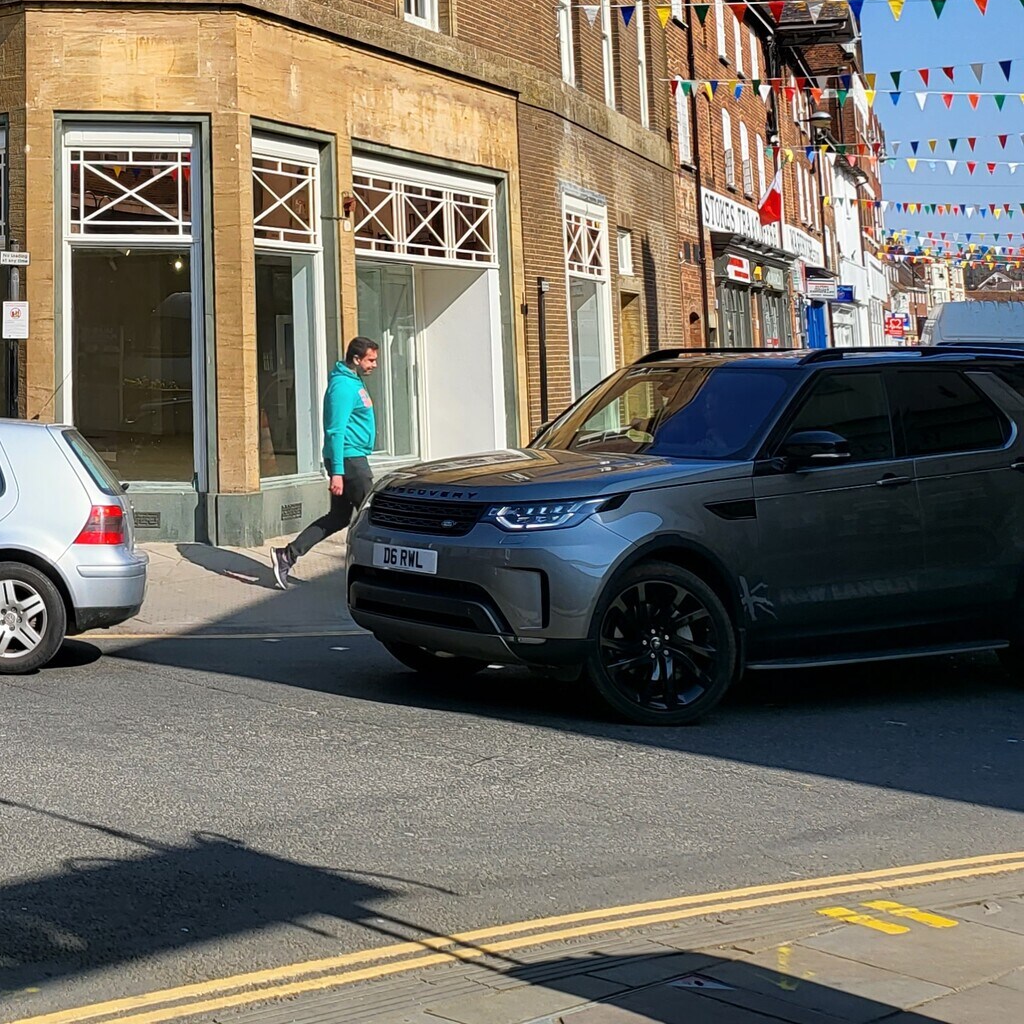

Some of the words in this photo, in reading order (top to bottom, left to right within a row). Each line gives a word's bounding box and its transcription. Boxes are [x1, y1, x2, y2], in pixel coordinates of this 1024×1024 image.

[704, 192, 735, 232] STOKES
[385, 486, 478, 499] DISCOVERY
[383, 547, 397, 565] D6
[400, 549, 423, 569] RWL
